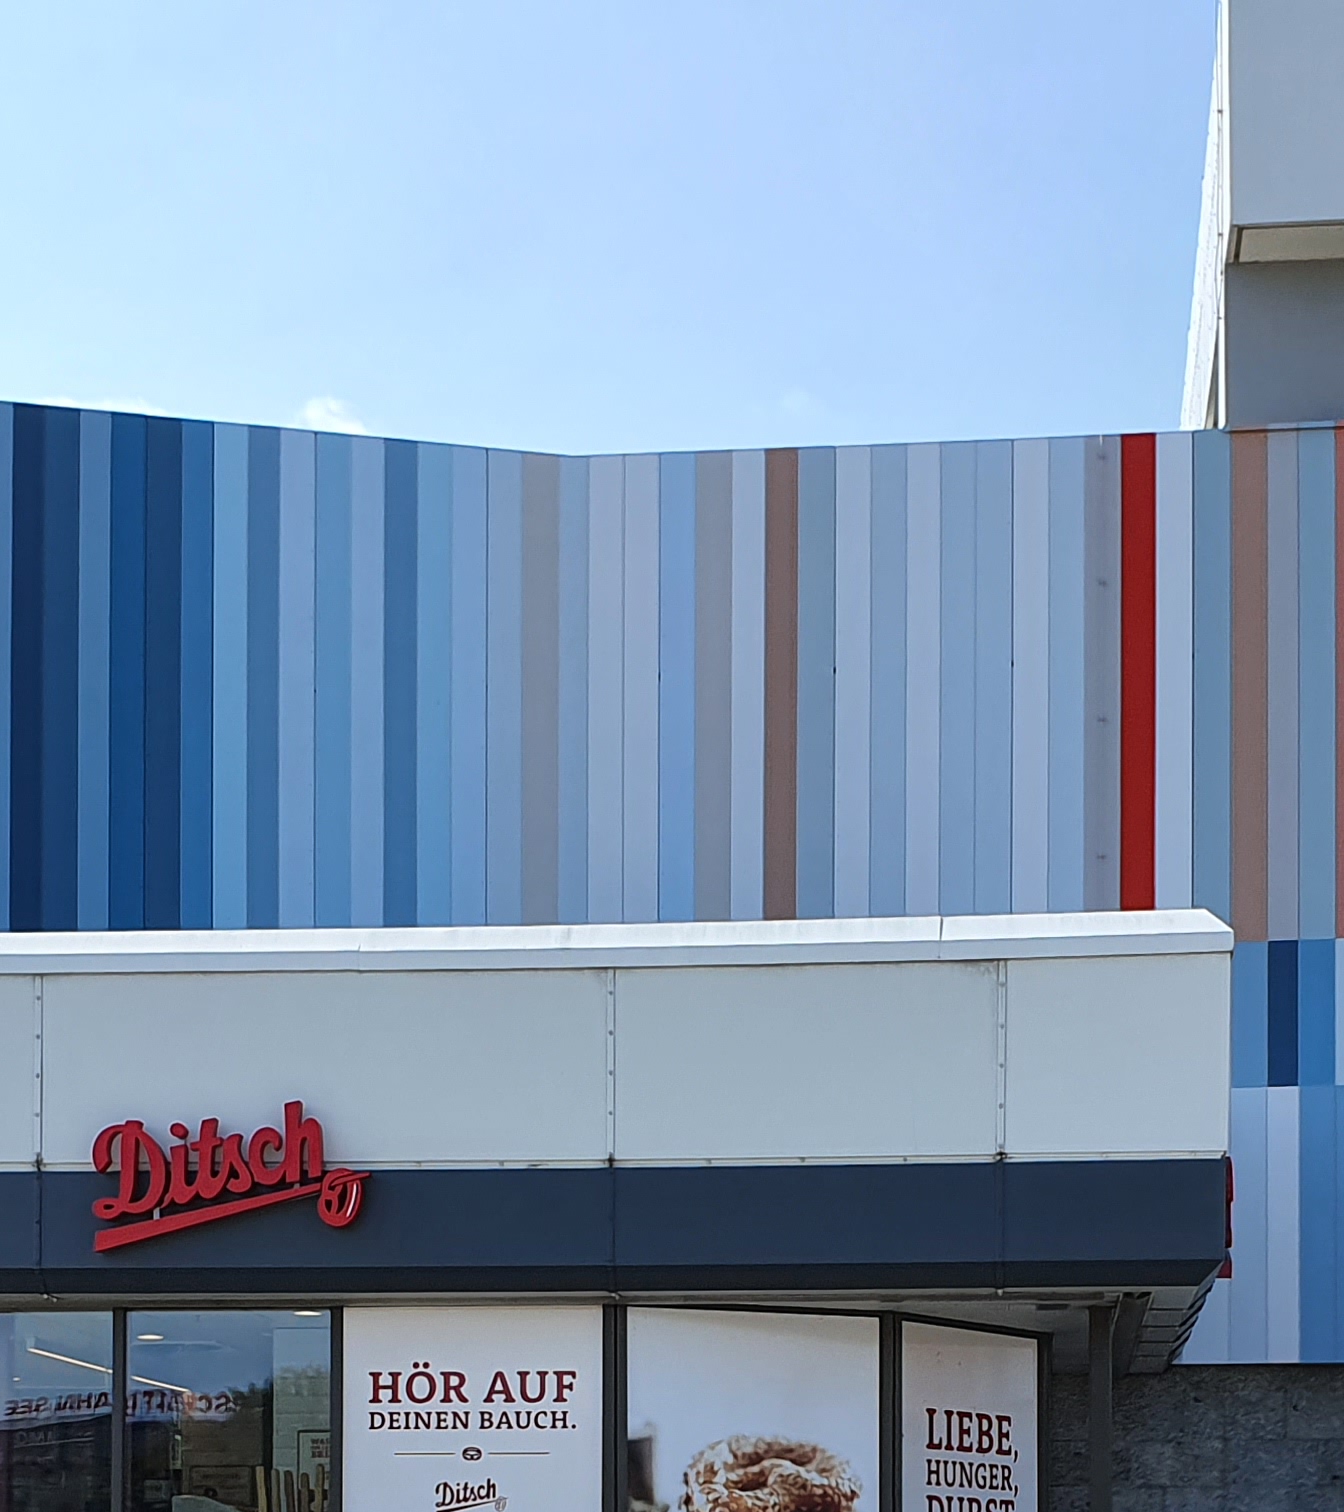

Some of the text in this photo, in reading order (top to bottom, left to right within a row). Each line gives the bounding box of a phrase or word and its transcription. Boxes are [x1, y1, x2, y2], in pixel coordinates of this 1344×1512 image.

[92, 1100, 324, 1220] Ditsch
[368, 1362, 577, 1404] HÖR AUF
[368, 1410, 577, 1430] DEINEN BAUCH.
[926, 1408, 1019, 1463] LIEBE,
[435, 1478, 497, 1508] Ditsch
[926, 1459, 1019, 1498] HUNGER,
